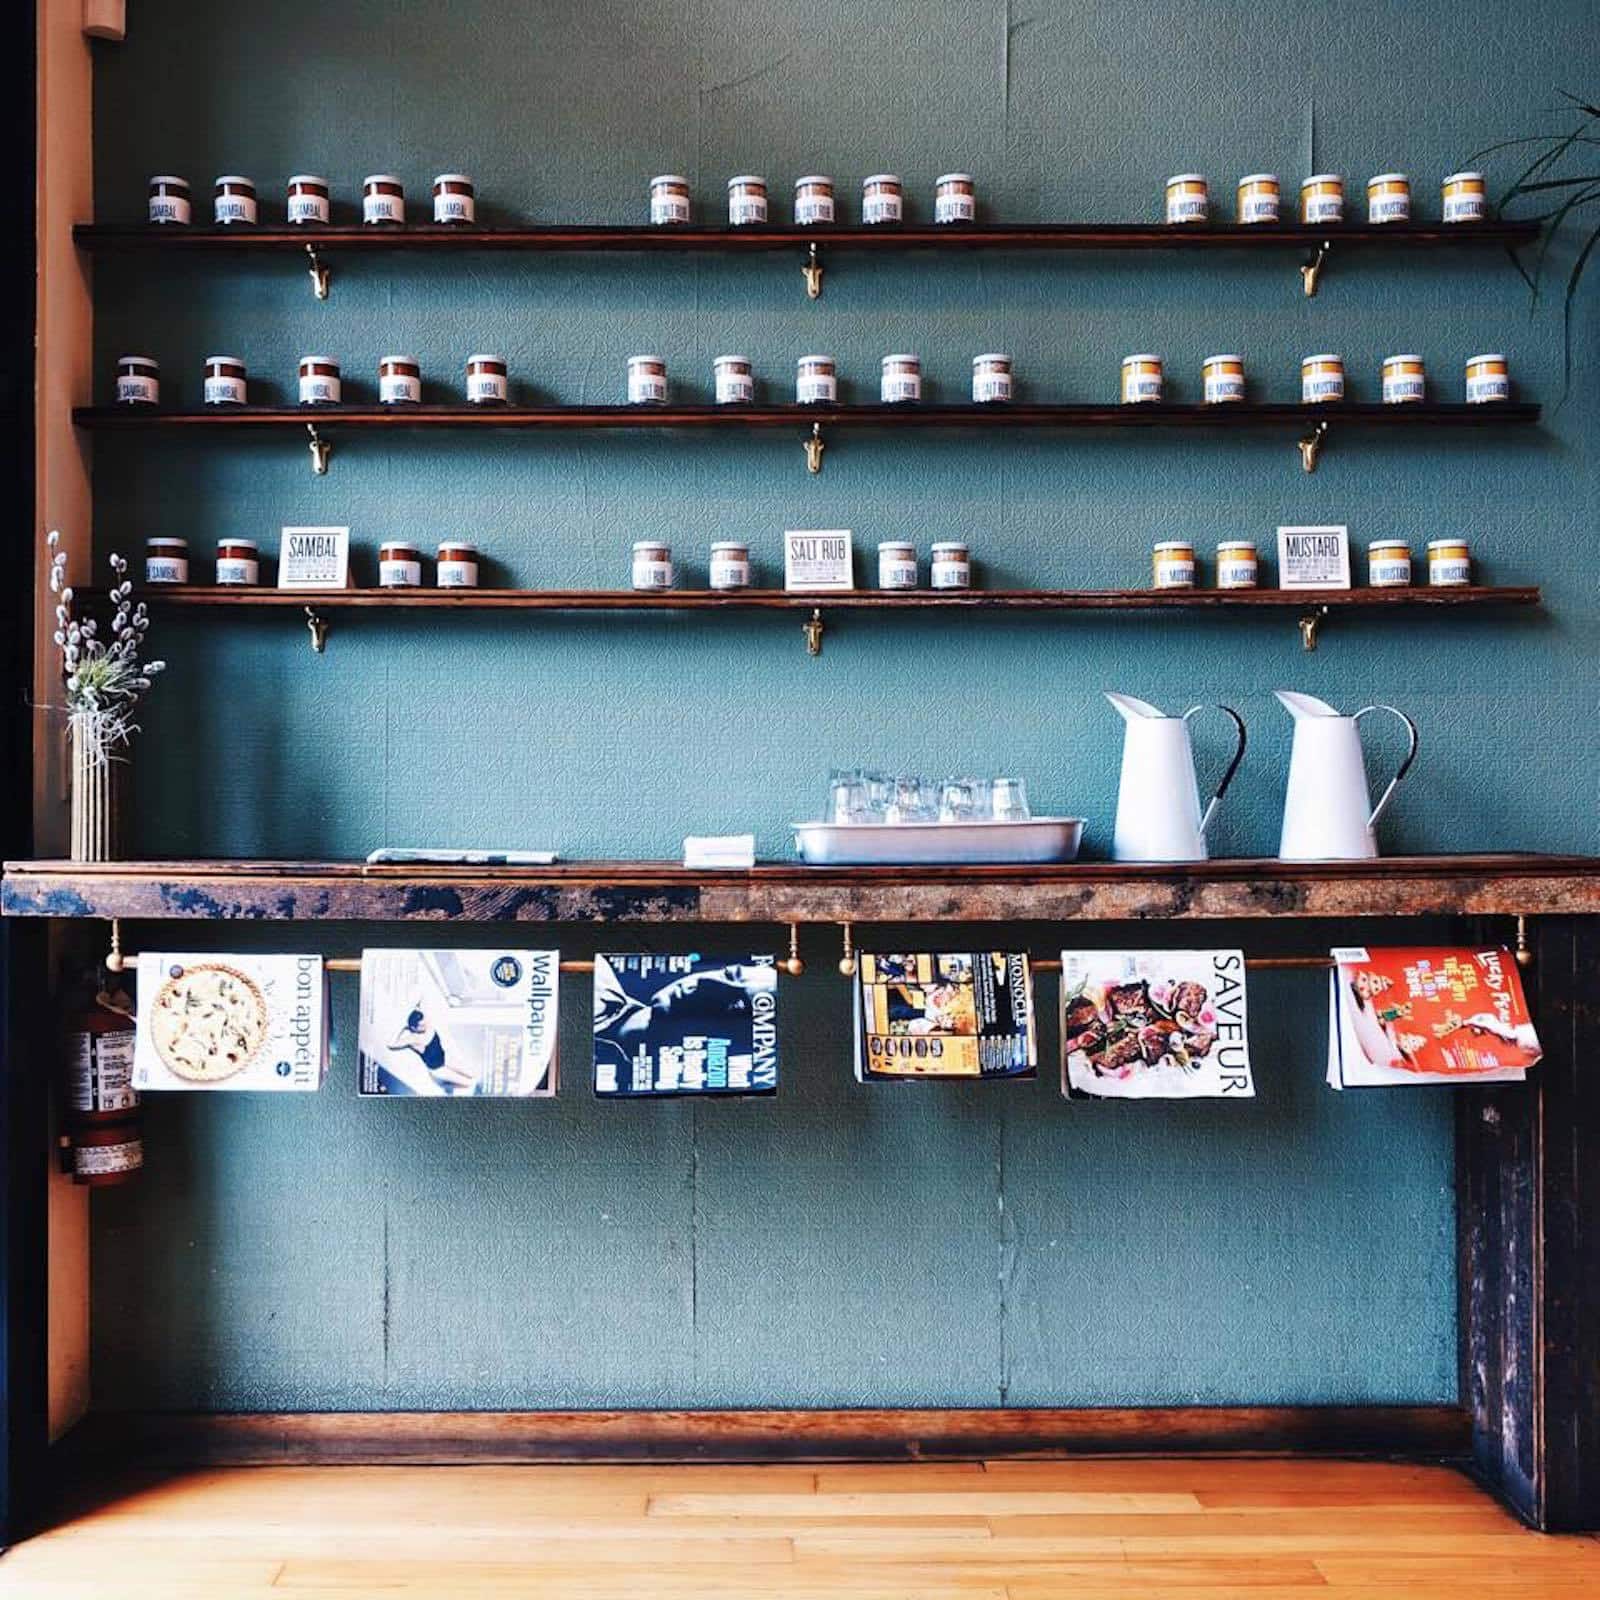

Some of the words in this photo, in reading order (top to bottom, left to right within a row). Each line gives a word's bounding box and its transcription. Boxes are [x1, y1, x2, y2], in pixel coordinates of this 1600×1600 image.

[289, 536, 338, 558] SAMBAL
[791, 540, 817, 561] SALT
[822, 540, 846, 560] RUB
[1285, 536, 1340, 558] MUSTARD
[297, 957, 319, 990] bon
[1009, 953, 1028, 1027] MONOCLE
[527, 954, 553, 1057] Wallpaper
[1213, 955, 1248, 1094] SAVEUR
[707, 1036, 732, 1088] Amazon
[751, 992, 776, 1086] COMPANY
